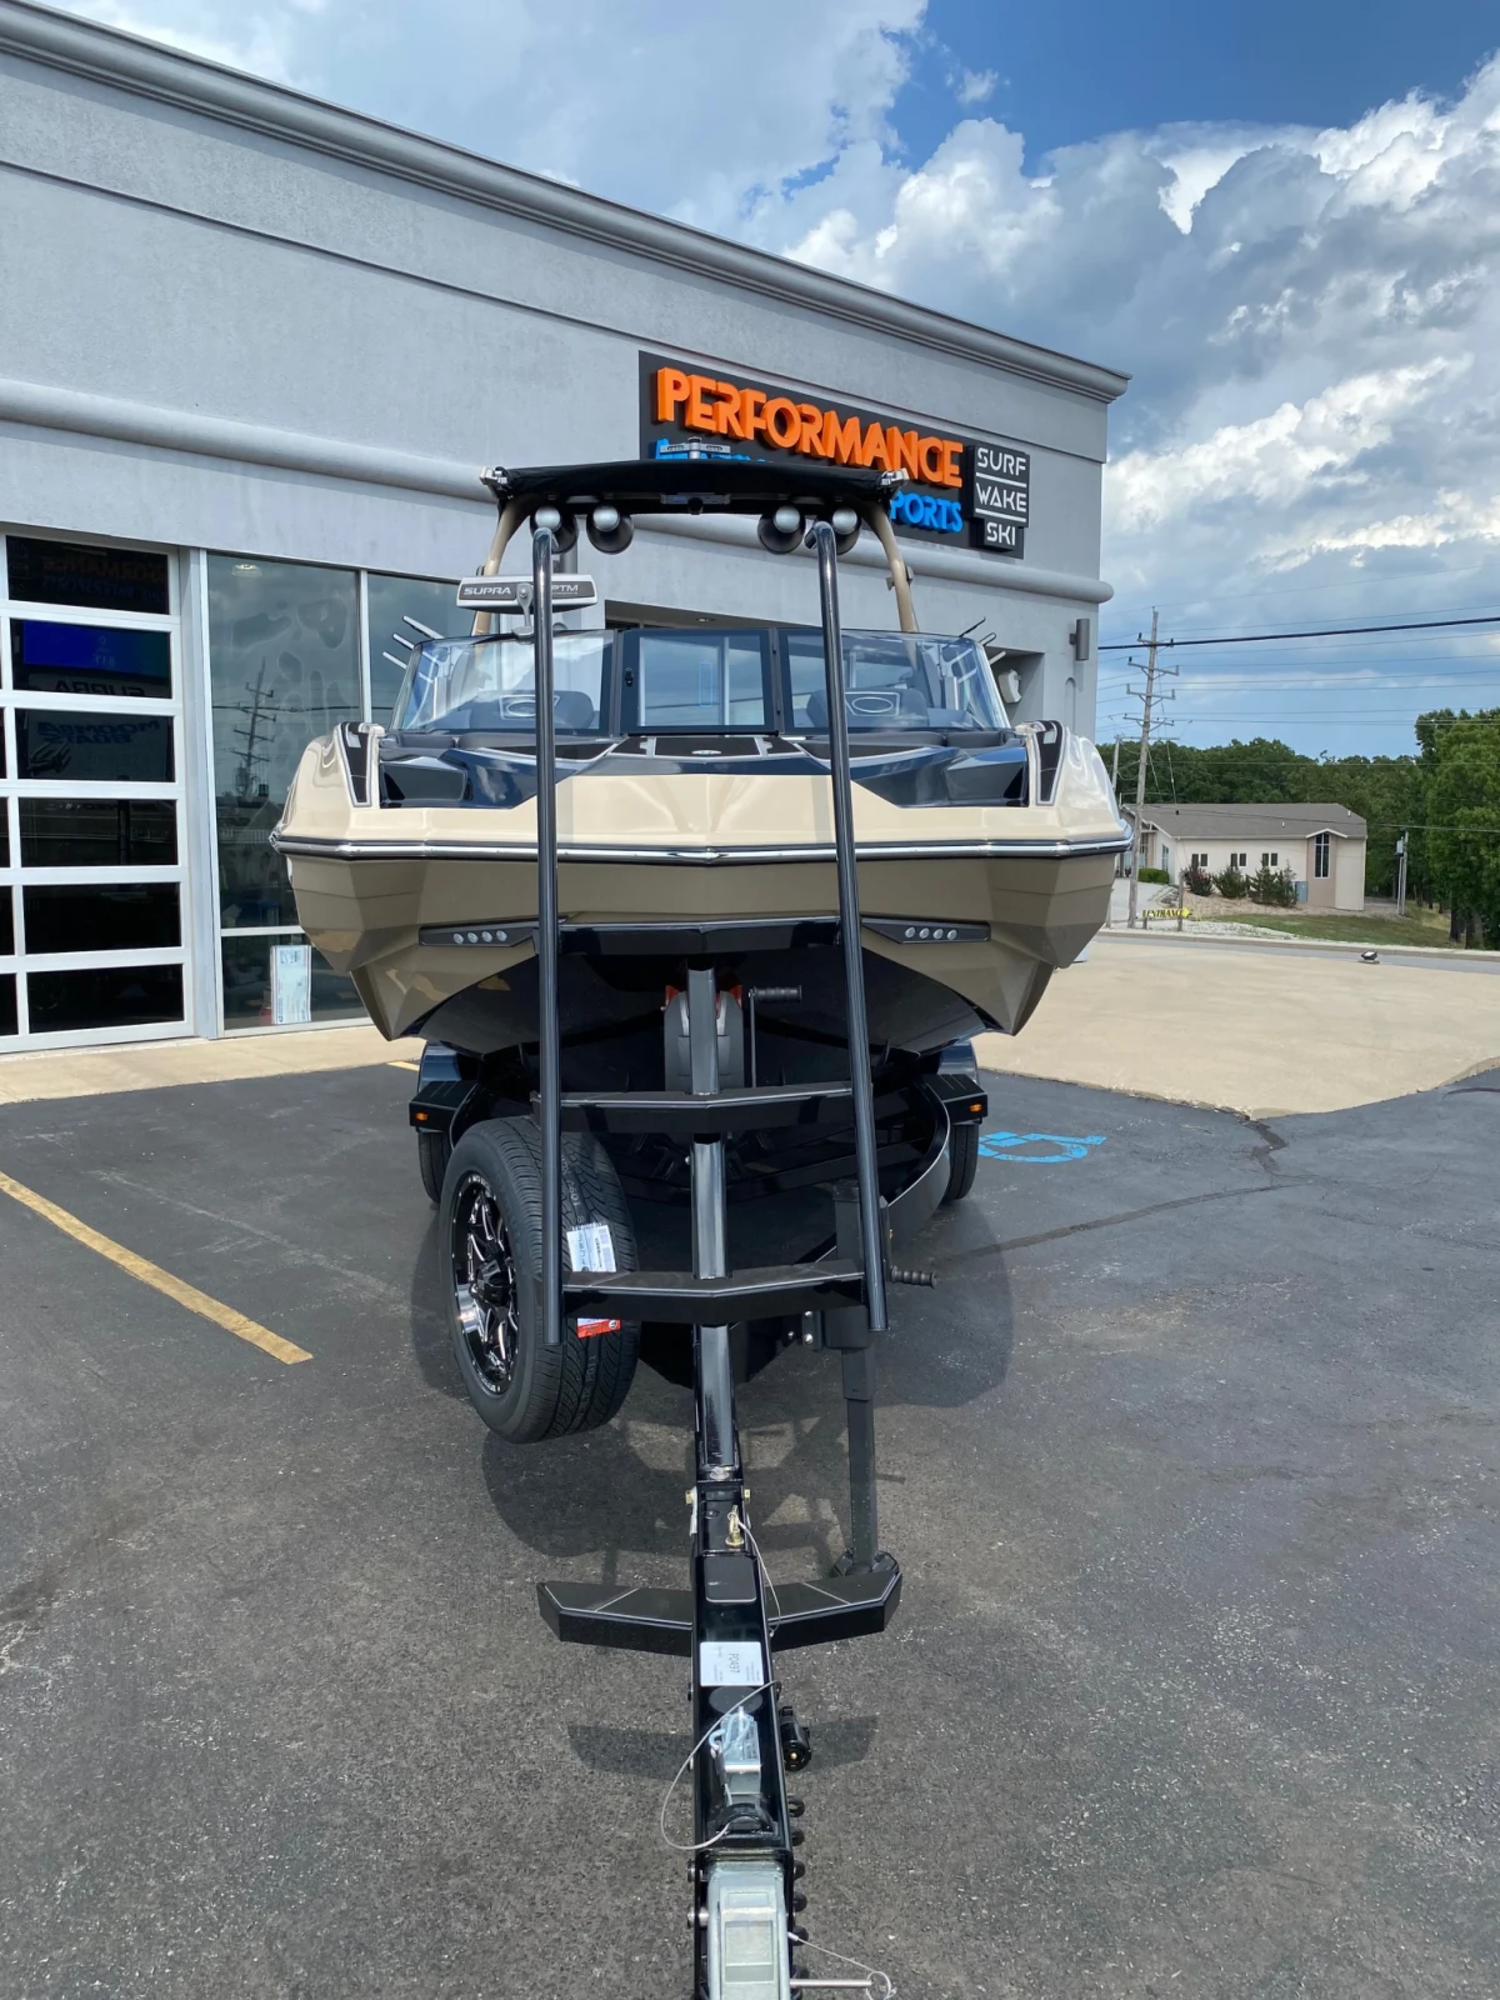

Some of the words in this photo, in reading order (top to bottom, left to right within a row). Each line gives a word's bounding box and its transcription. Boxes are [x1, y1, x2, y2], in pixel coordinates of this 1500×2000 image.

[656, 367, 963, 489] PERFORMANCE
[977, 447, 1027, 476] SURF
[889, 490, 964, 532] PORTS
[976, 482, 1027, 513] WAKE
[987, 521, 1015, 546] SKI
[463, 586, 511, 596] SUPRA
